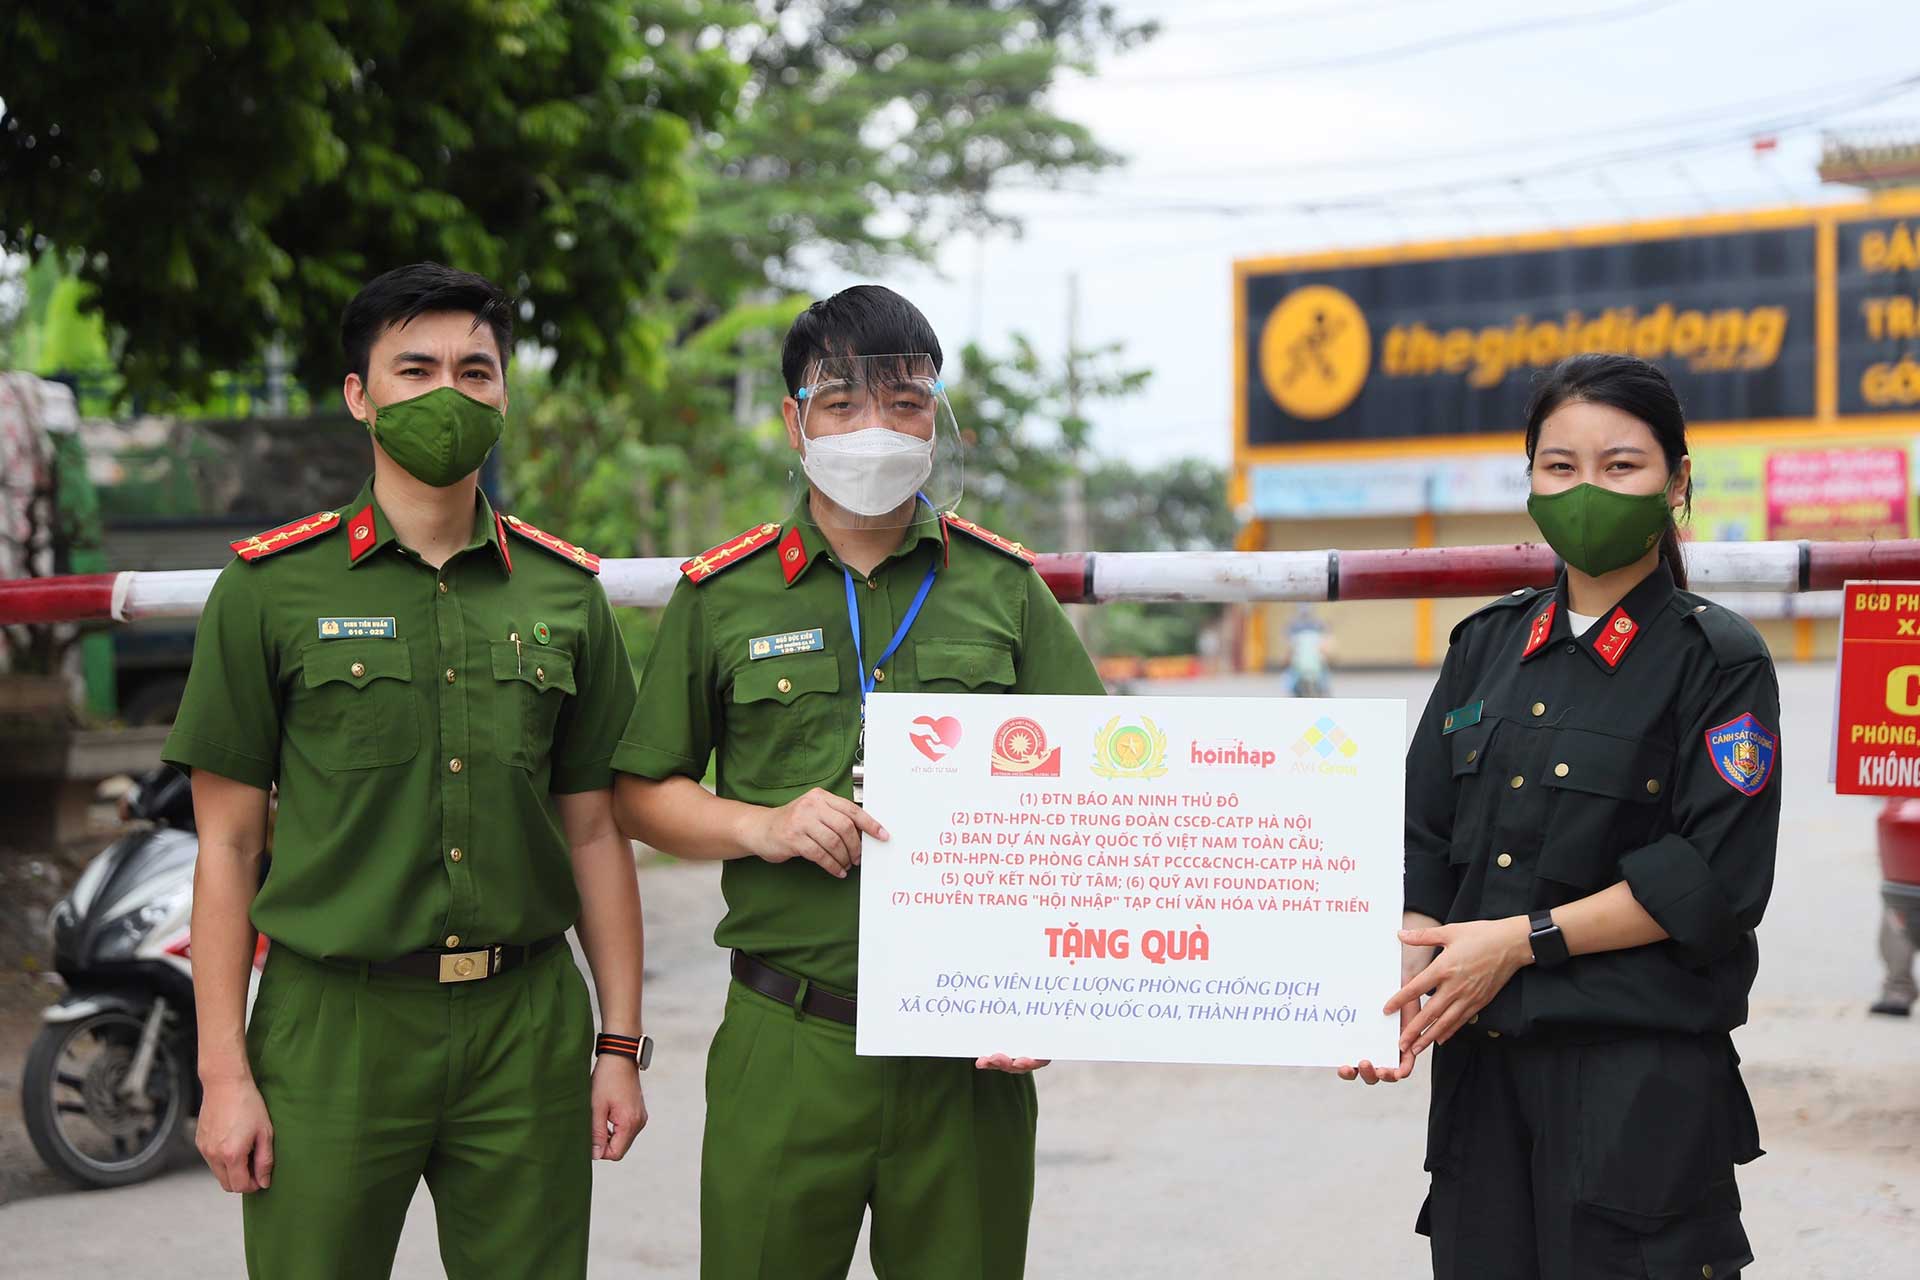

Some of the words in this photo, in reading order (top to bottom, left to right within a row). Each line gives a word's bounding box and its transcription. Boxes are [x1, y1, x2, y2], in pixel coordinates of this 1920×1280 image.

[1382, 302, 1789, 388] thegioididong
[1897, 618, 1920, 636] X
[1019, 793, 1038, 807] (1)
[1041, 793, 1073, 806] ĐTN
[1076, 791, 1108, 806] BÁO
[1111, 794, 1134, 807] AN
[1138, 795, 1178, 807] NINH
[1181, 792, 1213, 808] THỦ
[1215, 793, 1239, 808] ĐÔ
[951, 812, 970, 826] (2)
[972, 812, 1066, 826] ĐTN-HPN-CĐ
[1069, 814, 1121, 827] TRUNG
[1124, 812, 1170, 829] ĐOÀN
[1173, 816, 1254, 829] CSCĐ-CATP
[1258, 814, 1280, 829] HÀ
[1283, 815, 1312, 833] NỘI
[938, 832, 958, 847] (3)
[961, 832, 993, 845] BAN
[996, 833, 1021, 850] DỰ
[1023, 831, 1045, 846] ÁN
[1049, 831, 1091, 847] NGÀY
[1094, 832, 1139, 850] QUỐC
[1166, 833, 1199, 851] VIỆT
[1201, 837, 1238, 849] NAM
[1241, 834, 1285, 850] TOÀN
[1288, 835, 1324, 852] CẦU;
[910, 852, 929, 866] (4)
[932, 852, 1025, 866] ĐTN-HPN-CĐ
[1029, 851, 1083, 867] PHÒNG
[1087, 851, 1129, 868] CẢNH
[1133, 853, 1161, 869] SÁT
[1164, 856, 1298, 871] PCCC&CNCH-CATP
[1301, 856, 1324, 871] HÀ
[1327, 856, 1356, 874] NỘI
[940, 873, 960, 887] (5)
[963, 871, 995, 888] QUỸ
[1028, 871, 1057, 887] NỐI
[1060, 872, 1083, 888] TỪ
[1085, 872, 1123, 890] TÂM;
[1126, 876, 1145, 891] (6)
[1148, 874, 1181, 891] QUỸ
[1183, 877, 1209, 890] AVI
[1213, 878, 1320, 893] FOUNDATION;
[891, 892, 911, 906] (7)
[914, 890, 974, 905] CHUYÊN
[977, 894, 1028, 907] TRANG
[1123, 897, 1152, 912] TẠP
[1155, 894, 1182, 910] CHÍ
[1184, 895, 1216, 911] VĂN
[1220, 896, 1255, 911] HÓA
[1257, 896, 1279, 912] VÀ
[1282, 895, 1323, 912] PHÁT
[1043, 922, 1130, 966] TẶNG
[1140, 924, 1210, 965] QUÀ
[935, 971, 990, 993] ĐỘNG
[993, 972, 1032, 990] VIÊN
[1034, 976, 1070, 995] LỰC
[1072, 977, 1136, 996] LƯỢNG
[1138, 976, 1202, 994] PHÒNG
[1205, 976, 1271, 996] CHỐNG
[1273, 982, 1321, 1000] DỊCH
[925, 996, 977, 1017] CỘNG
[979, 997, 1021, 1017] HÒA,
[1025, 999, 1087, 1020] HUYỆN
[1089, 999, 1145, 1021] QUỐC
[1147, 1004, 1182, 1021] OAI,
[1187, 1002, 1250, 1021] THÀNH
[1252, 1002, 1292, 1022] PHỐ
[1294, 1005, 1319, 1023] HÀ
[1322, 1006, 1357, 1027] NỘI
